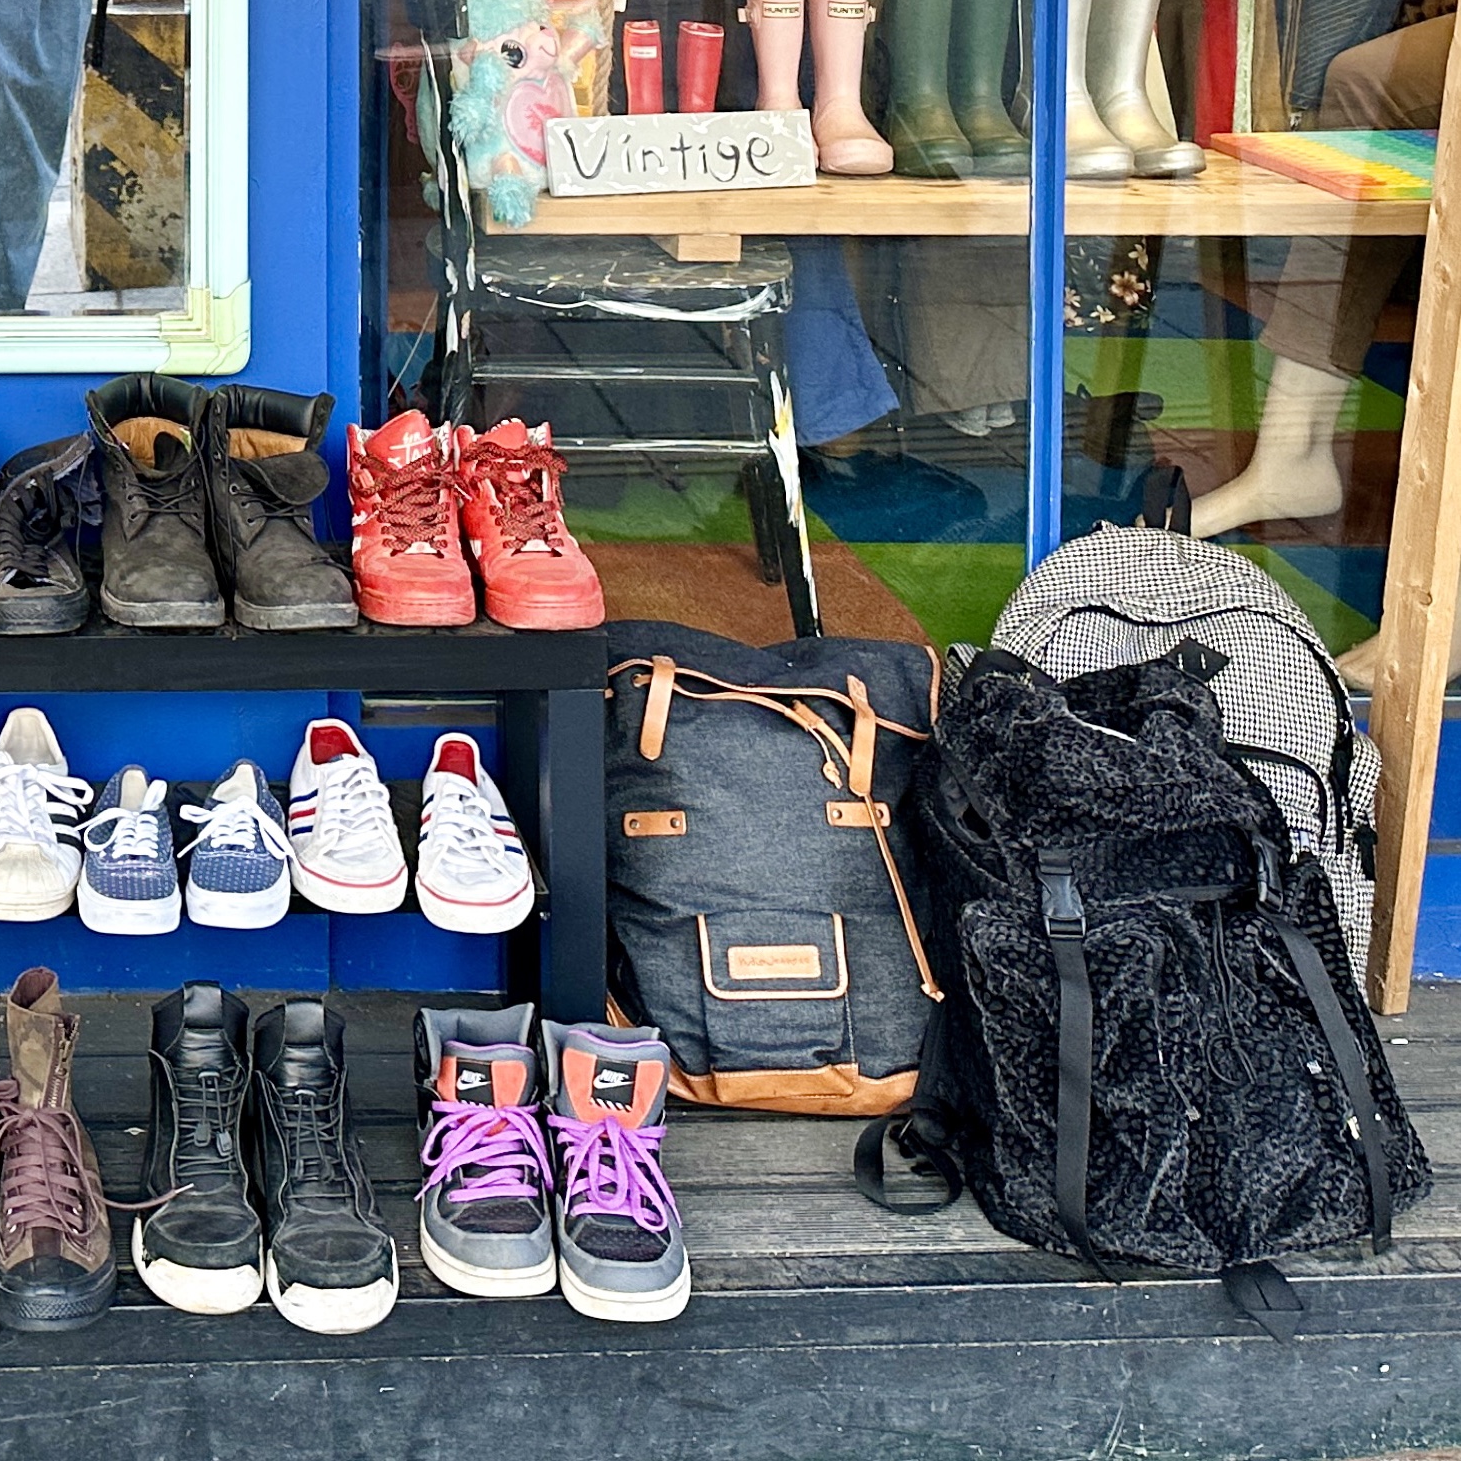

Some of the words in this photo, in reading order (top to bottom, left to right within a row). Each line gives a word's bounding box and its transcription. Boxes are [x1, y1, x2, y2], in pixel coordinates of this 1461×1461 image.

[764, 5, 800, 15] HUNTER
[829, 5, 865, 15] HUNTER
[563, 128, 782, 183] Vintige
[461, 1069, 486, 1083] NIKE
[599, 1068, 630, 1082] NIKE
